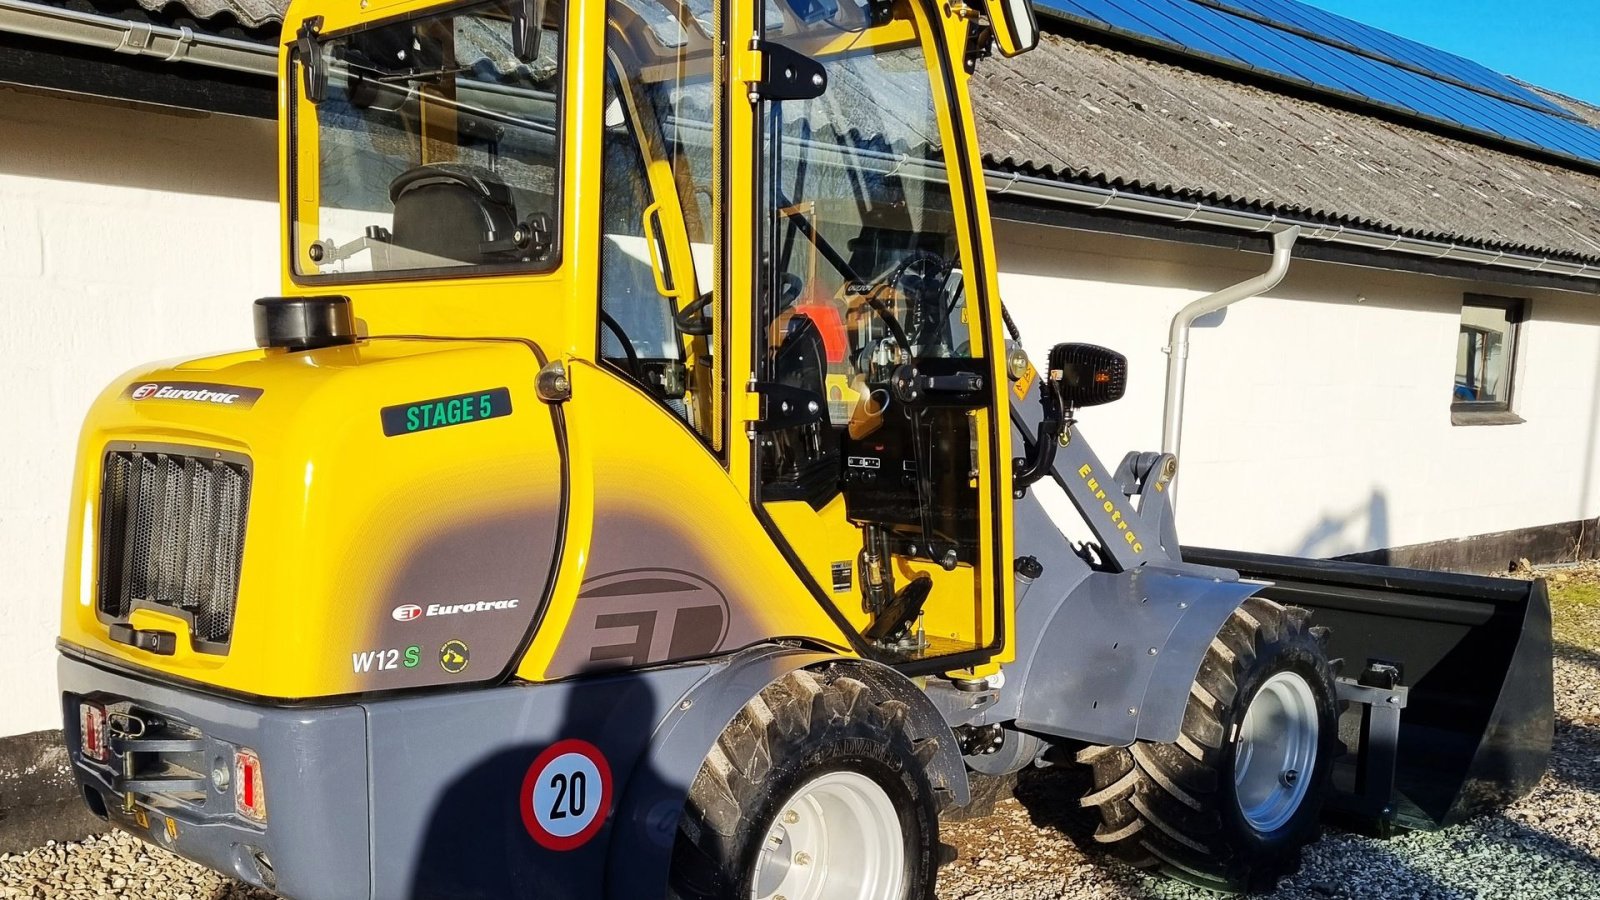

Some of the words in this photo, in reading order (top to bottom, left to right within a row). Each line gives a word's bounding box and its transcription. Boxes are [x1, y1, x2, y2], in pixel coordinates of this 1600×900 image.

[155, 386, 239, 404] Eurotrac
[406, 397, 474, 431] STAGE
[480, 394, 491, 418] 5
[1079, 464, 1142, 553] Eurotrac
[397, 605, 421, 621] ET
[426, 599, 519, 617] Eurotrac
[352, 649, 399, 673] W12
[403, 645, 421, 669] S
[550, 771, 586, 820] 20
